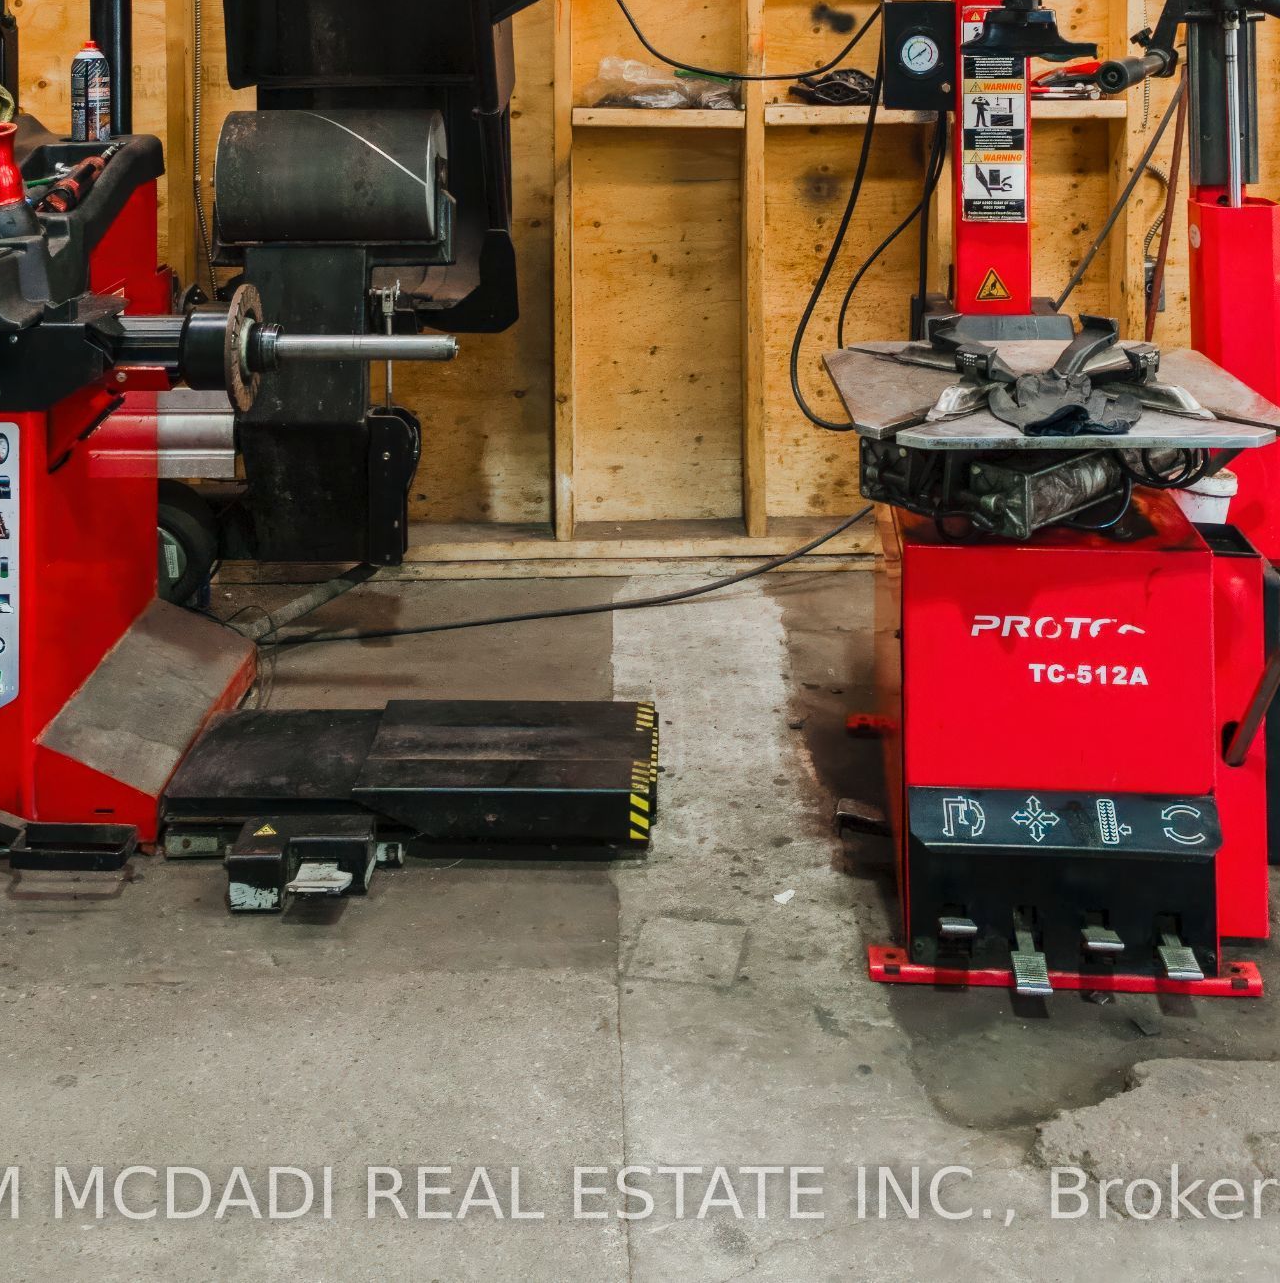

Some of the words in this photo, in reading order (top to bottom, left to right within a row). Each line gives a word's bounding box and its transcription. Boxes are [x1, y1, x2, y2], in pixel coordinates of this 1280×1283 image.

[983, 82, 1022, 91] WARNING
[983, 153, 1023, 162] WARNING
[1028, 663, 1149, 686] TC-512A
